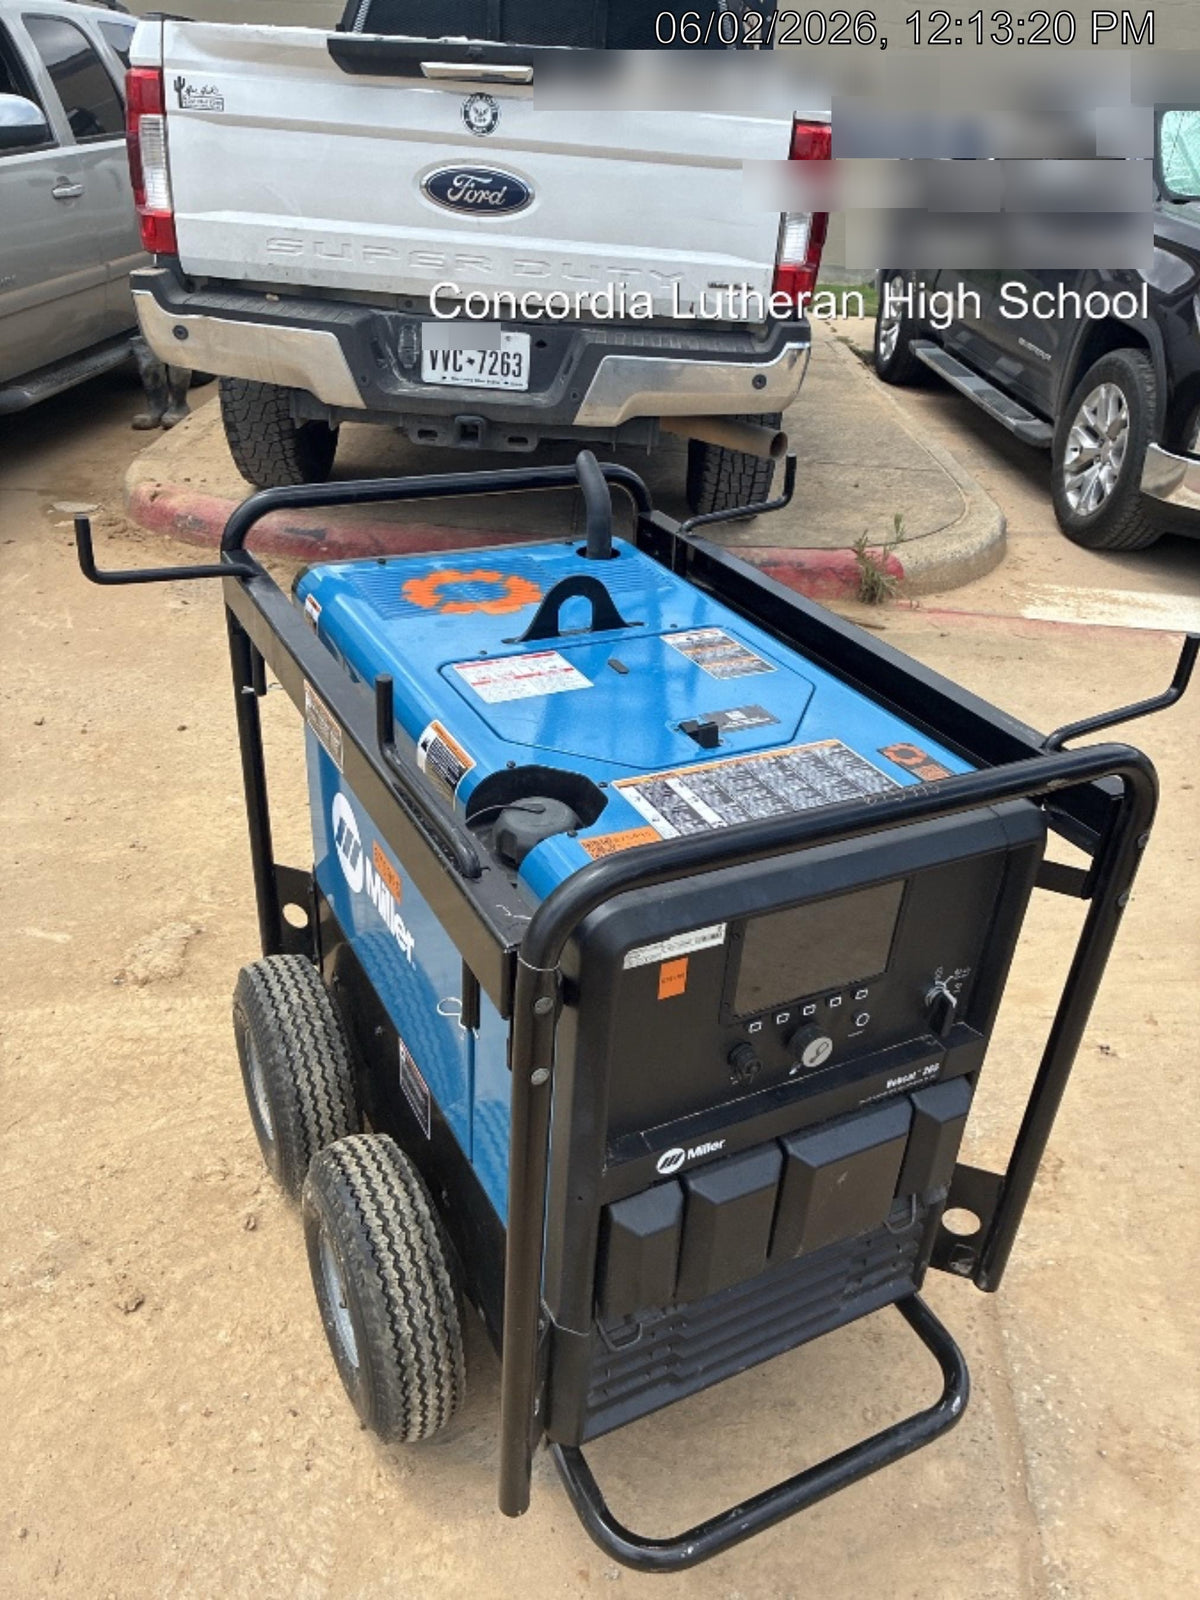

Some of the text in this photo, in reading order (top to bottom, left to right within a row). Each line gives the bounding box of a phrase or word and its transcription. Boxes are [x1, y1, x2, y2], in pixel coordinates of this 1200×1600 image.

[447, 173, 508, 206] Ford
[266, 237, 687, 289] SUPER DUTY
[365, 855, 416, 964] Miller
[687, 1138, 726, 1160] Miller
